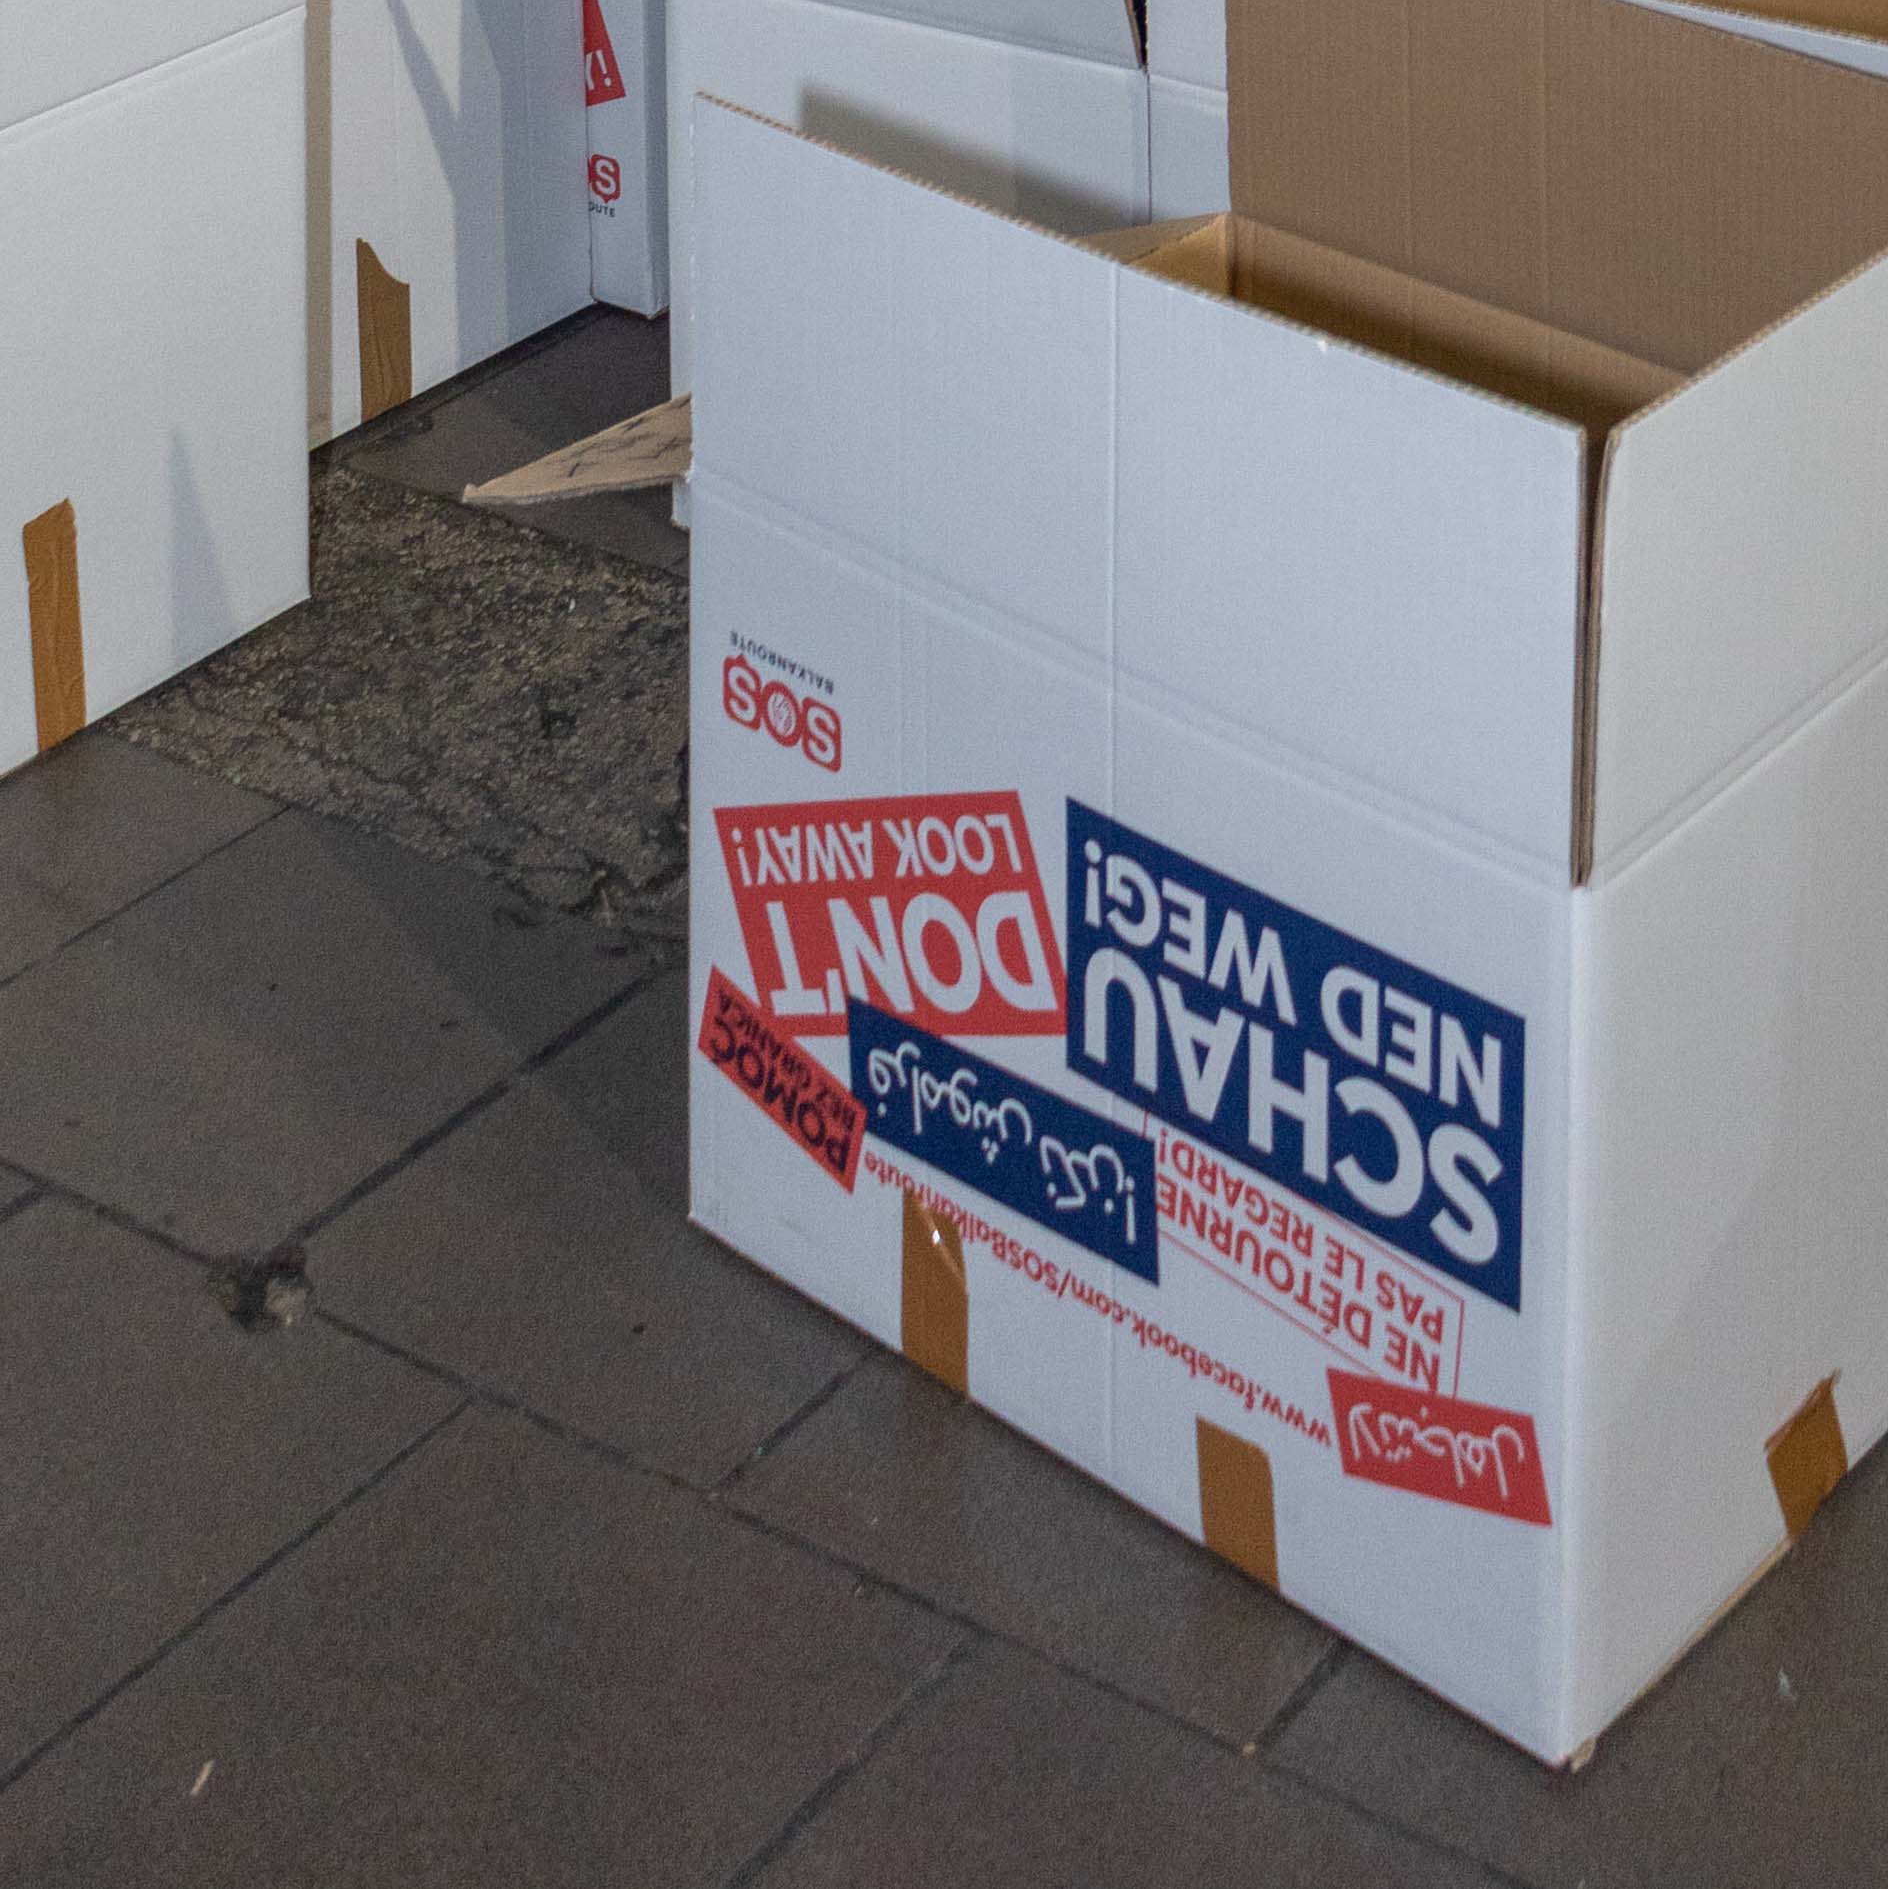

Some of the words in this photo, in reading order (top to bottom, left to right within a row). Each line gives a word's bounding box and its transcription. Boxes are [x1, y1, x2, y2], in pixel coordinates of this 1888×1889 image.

[729, 665, 838, 764] SOS
[1084, 839, 1293, 1018] WEG!
[1084, 948, 1502, 1267] SCHAU
[1322, 966, 1501, 1128] NED
